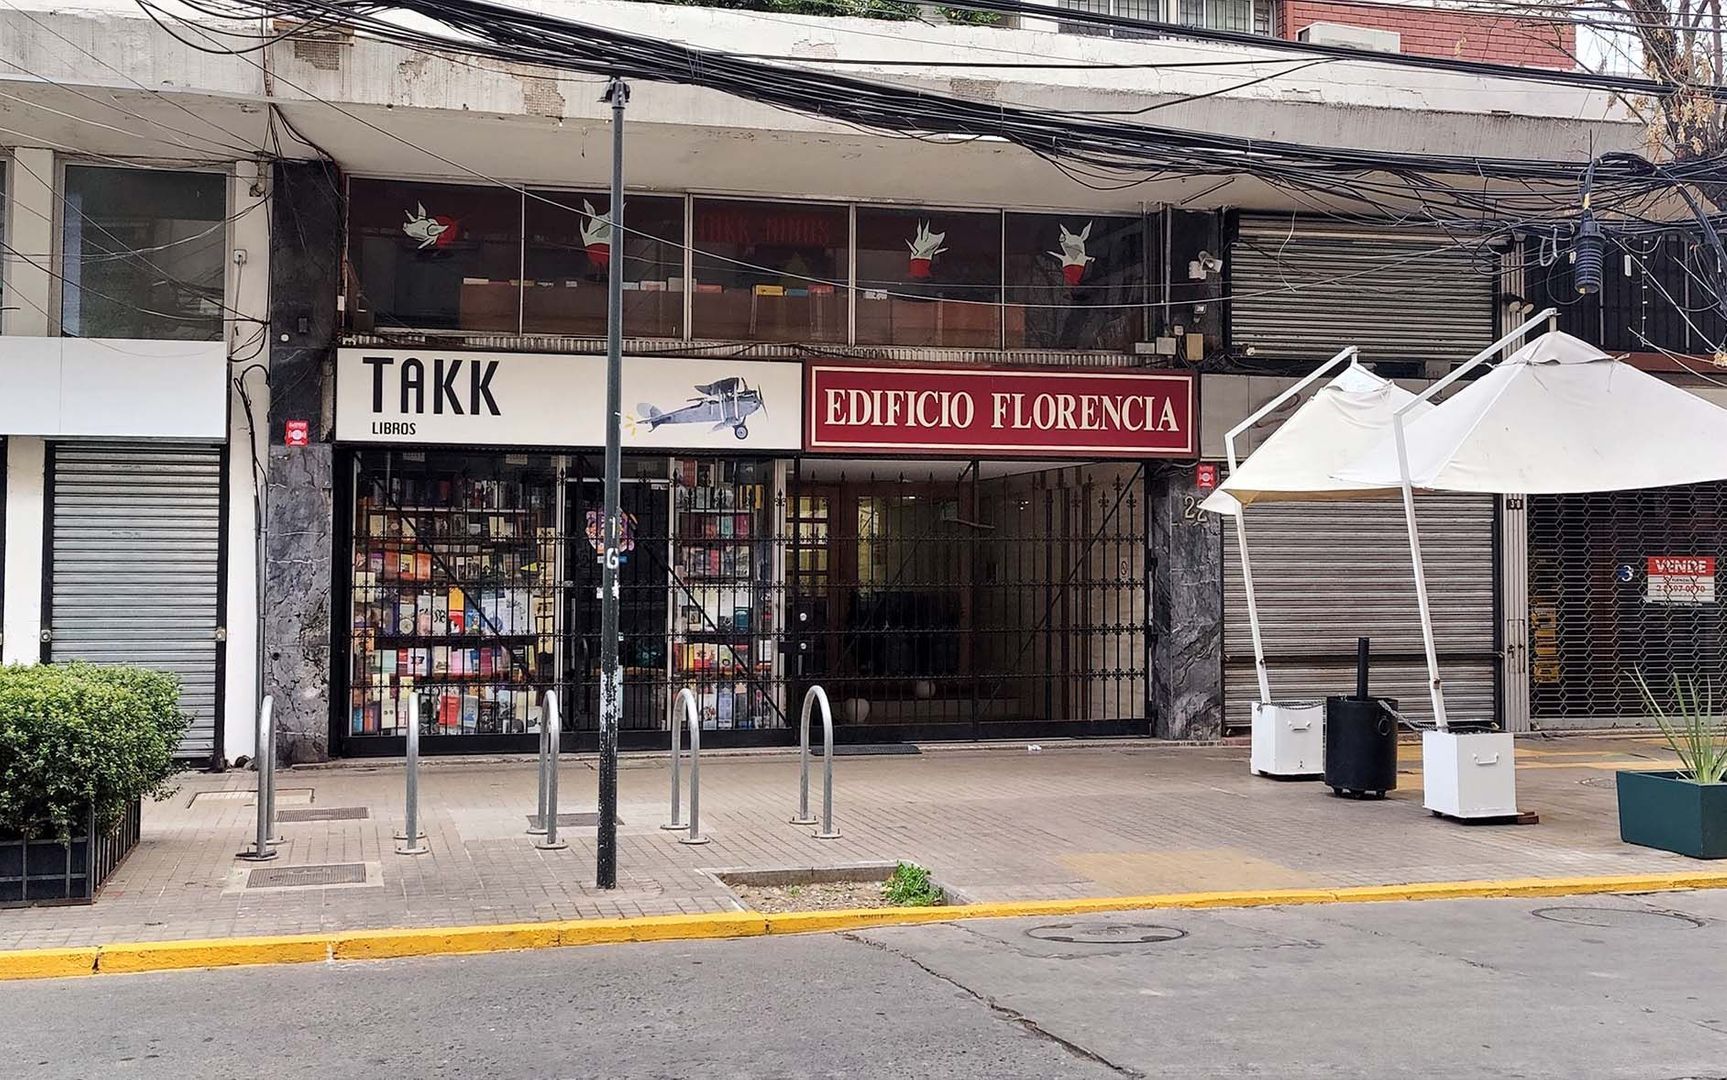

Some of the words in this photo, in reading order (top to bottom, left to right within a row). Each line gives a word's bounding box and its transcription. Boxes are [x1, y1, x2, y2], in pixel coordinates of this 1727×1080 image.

[362, 356, 501, 416] TAKK
[824, 388, 974, 428] EDIFICIO
[990, 392, 1180, 432] FLORENCIA
[371, 421, 417, 436] LIBROS
[1655, 559, 1707, 573] VENDE
